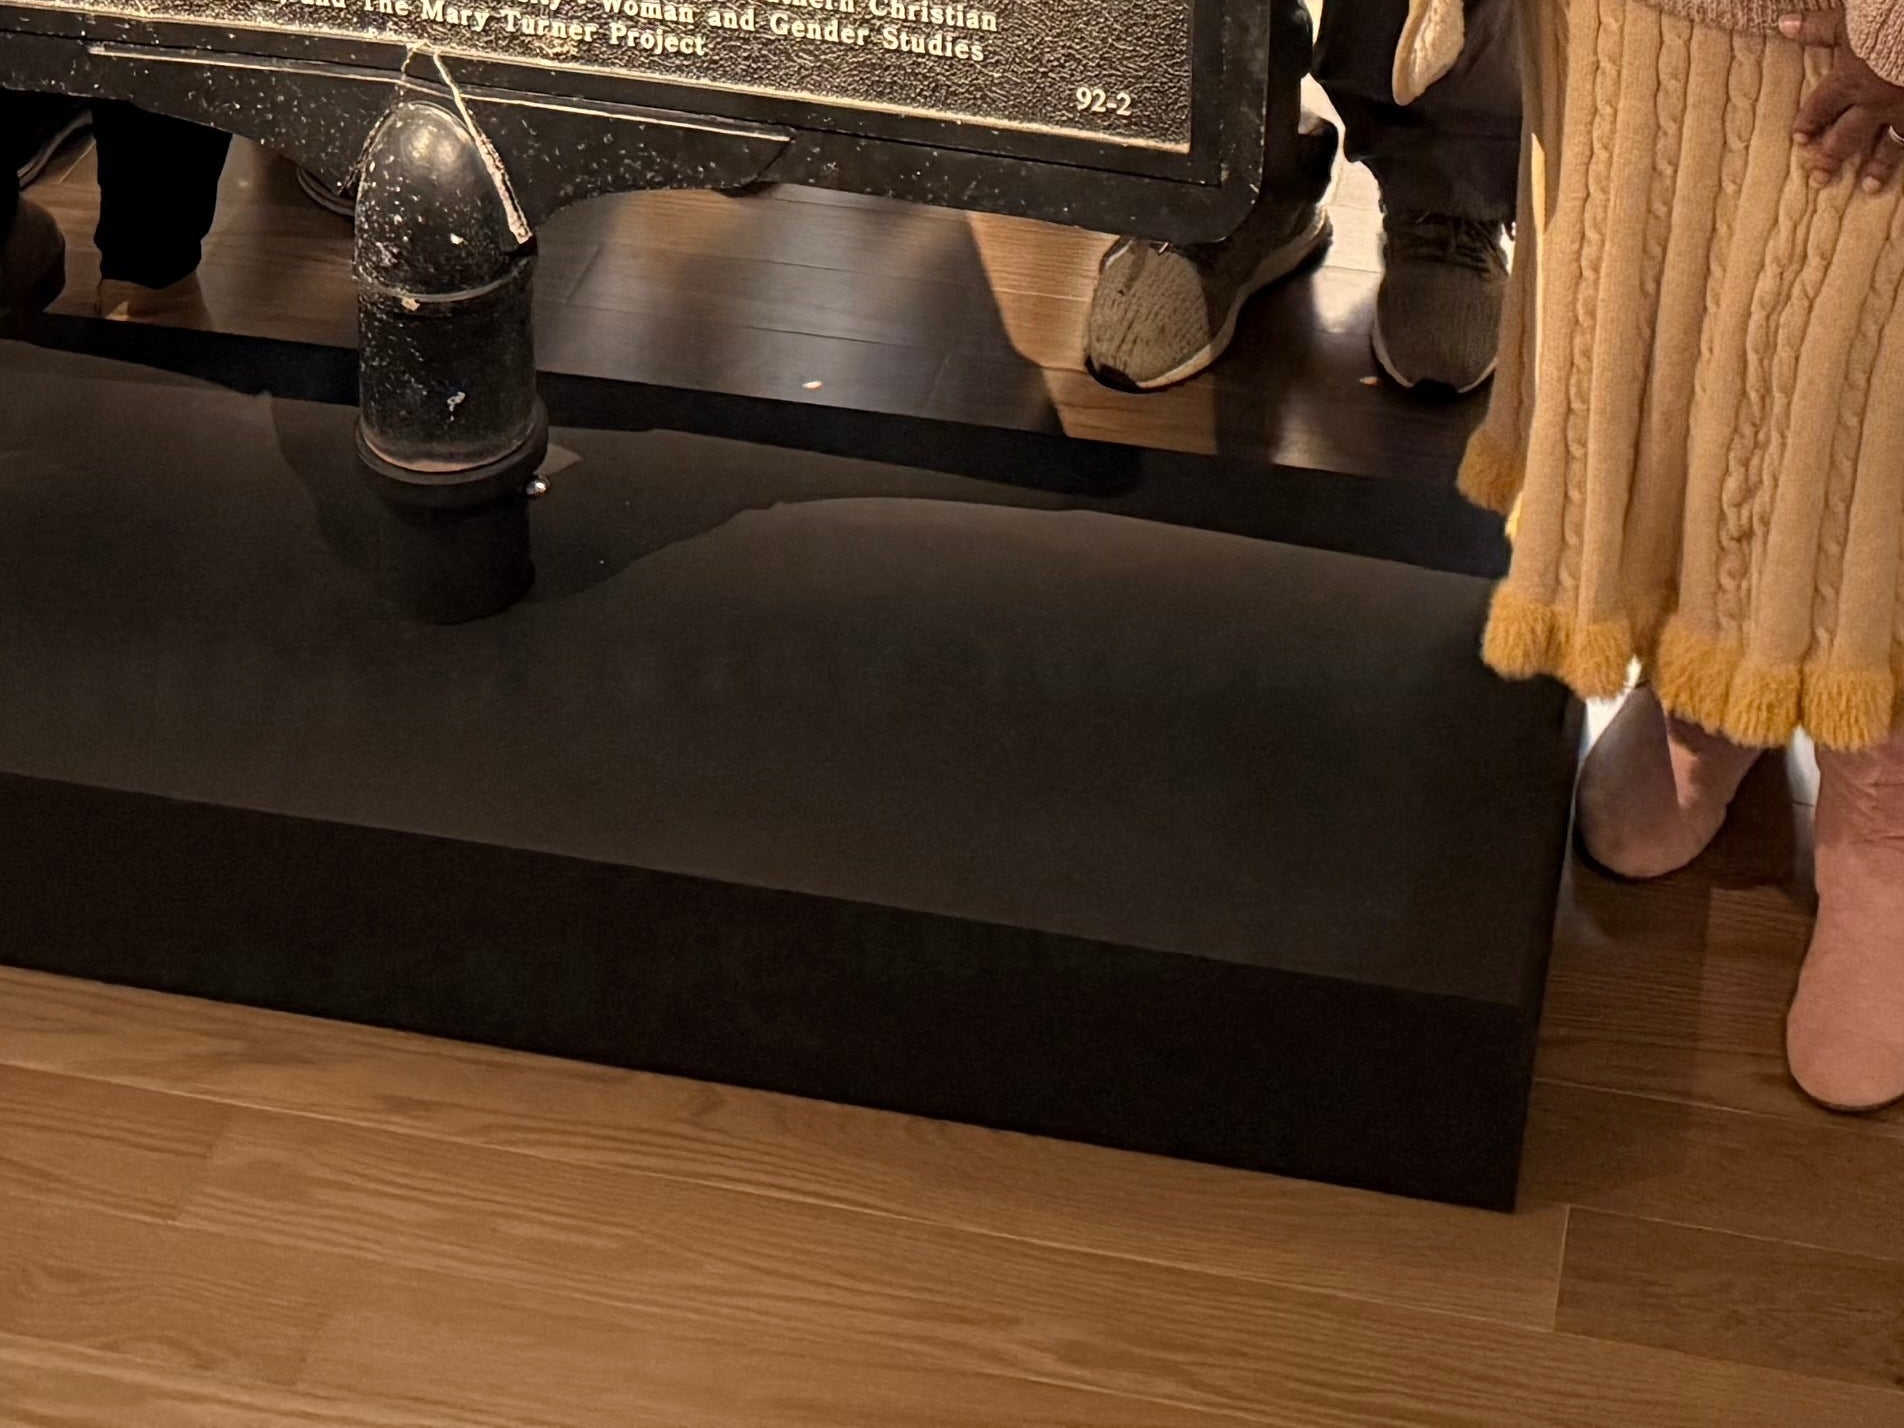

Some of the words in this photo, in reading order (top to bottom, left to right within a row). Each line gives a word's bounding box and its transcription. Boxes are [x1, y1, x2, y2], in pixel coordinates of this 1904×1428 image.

[502, 8, 597, 41] Turner
[608, 20, 705, 55] Project
[707, 6, 754, 30] and
[769, 10, 870, 45] Gender
[881, 24, 985, 60] Studies
[1076, 85, 1132, 116] 92-2
